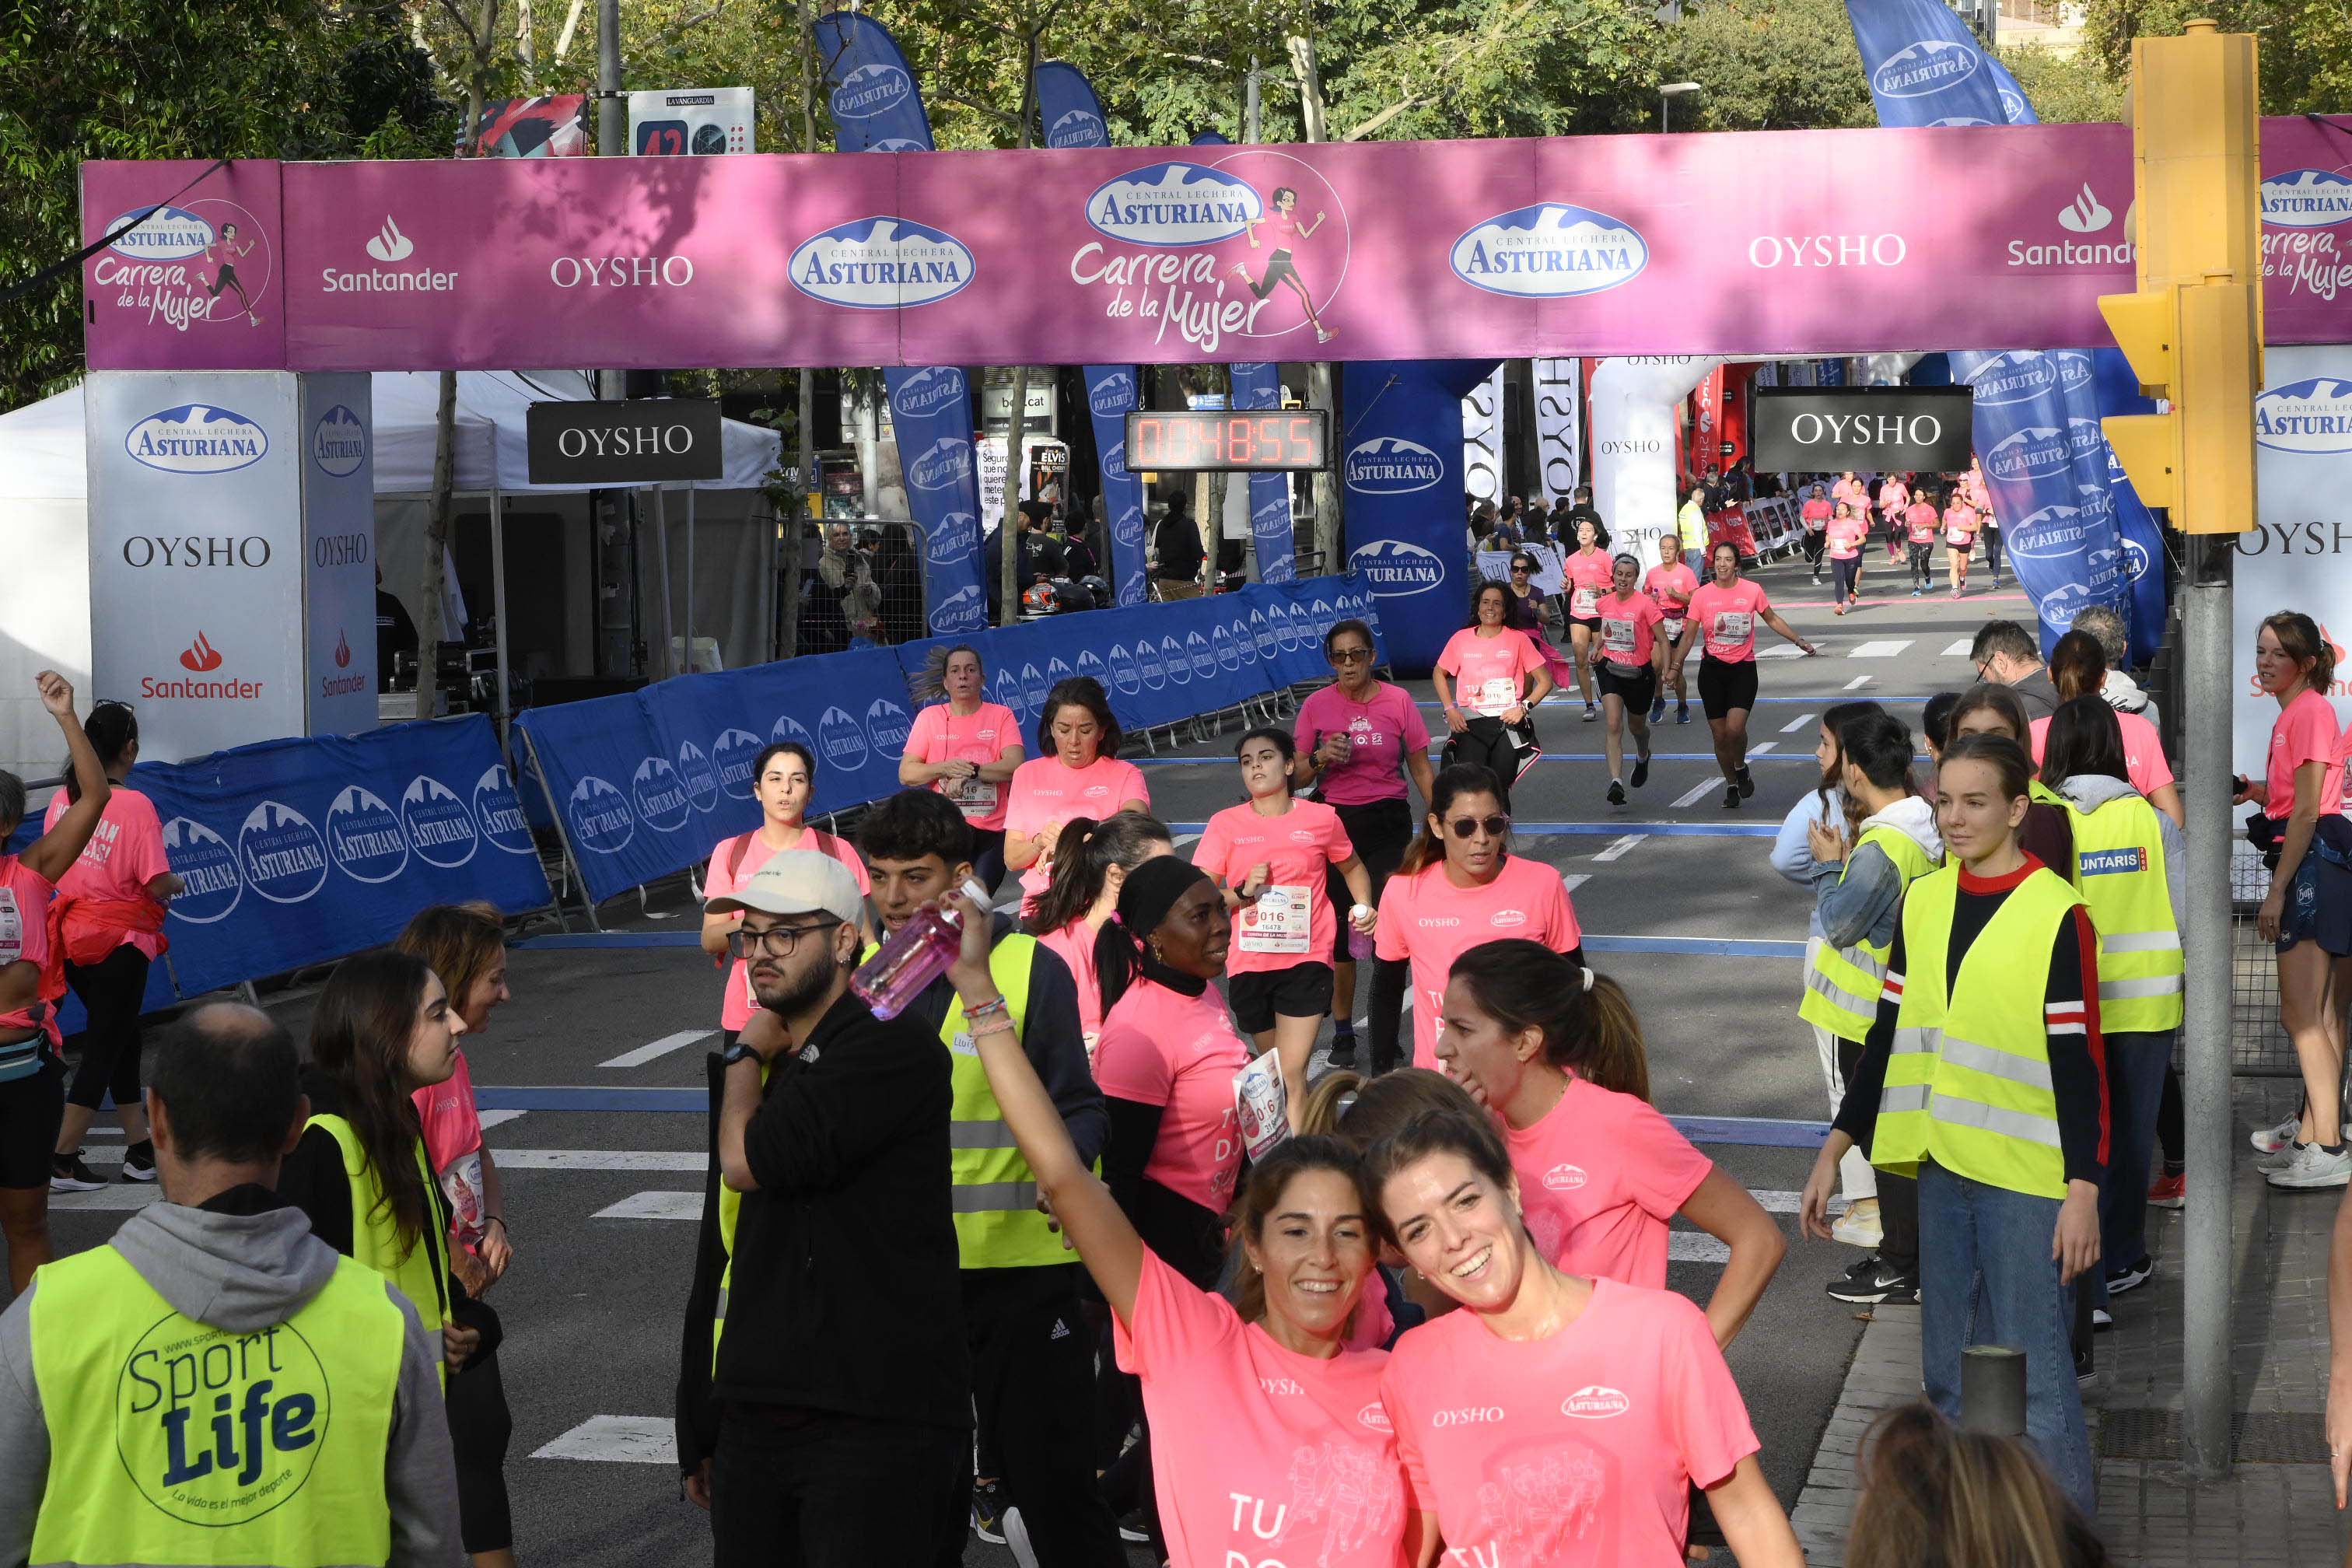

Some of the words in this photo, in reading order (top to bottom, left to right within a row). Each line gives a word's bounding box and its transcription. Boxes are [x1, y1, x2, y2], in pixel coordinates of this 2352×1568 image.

[677, 96, 713, 105] VANGUARDIA
[1125, 190, 1185, 200] CENTRAL
[1187, 189, 1244, 199] LECHERA
[1098, 194, 1247, 225] ASTURIANA
[831, 249, 890, 257] CENTRAL
[896, 248, 954, 257] LECHERA
[1496, 236, 1555, 246] CENTRAL
[1561, 234, 1626, 244] LECHERA
[1748, 233, 1906, 268] OYSHO
[2261, 233, 2335, 254] arrera
[802, 251, 961, 285] ASTURIANA
[1070, 242, 1216, 285] Carrera
[1465, 240, 1633, 274] ASTURIANA
[94, 257, 187, 285] Carrera
[323, 266, 458, 292] Santander
[550, 256, 694, 288] OYSHO
[2280, 256, 2293, 276] la
[2290, 250, 2352, 301] Muje
[117, 288, 135, 307] de
[138, 286, 149, 306] la
[149, 280, 220, 331] Mujer
[1106, 288, 1133, 317] de
[1140, 287, 1158, 317] la
[1155, 280, 1272, 353] Mujer
[137, 429, 258, 456] ASTURIANA
[558, 425, 694, 457] OYSHO
[1791, 413, 1941, 446] OYSHO
[317, 438, 363, 459] ASTURIANA
[1041, 453, 1065, 462] ELVIS
[1601, 439, 1661, 455] OYSHO
[984, 474, 1007, 484] quiere
[1349, 460, 1436, 481] ASTURIANA
[123, 536, 271, 568] OYSHO
[316, 533, 368, 568] OYSHO
[142, 677, 263, 699] Santander
[322, 673, 366, 699] Santander
[254, 836, 282, 849] CENTRAL
[285, 830, 312, 844] LECHERA
[334, 825, 405, 863] ASTURIANA
[408, 813, 474, 848] ASTURIANA
[172, 853, 194, 866] ENTRAL
[198, 848, 225, 860] LECHERA
[247, 844, 325, 882] ASTURIANA
[2080, 854, 2137, 870] UNTARIS
[1261, 912, 1284, 921] 016
[1419, 918, 1460, 927] OYSHO
[129, 1326, 282, 1413] Sport
[1433, 1406, 1504, 1427] OYSHO
[1568, 1400, 1624, 1413] ASTURIANA
[162, 1380, 316, 1487] Life
[172, 1489, 184, 1500] La
[187, 1496, 208, 1508] vida
[209, 1500, 219, 1509] es
[220, 1499, 229, 1509] el
[232, 1491, 257, 1507] mejor
[259, 1468, 292, 1497] deporte
[1229, 1493, 1286, 1539] TU
